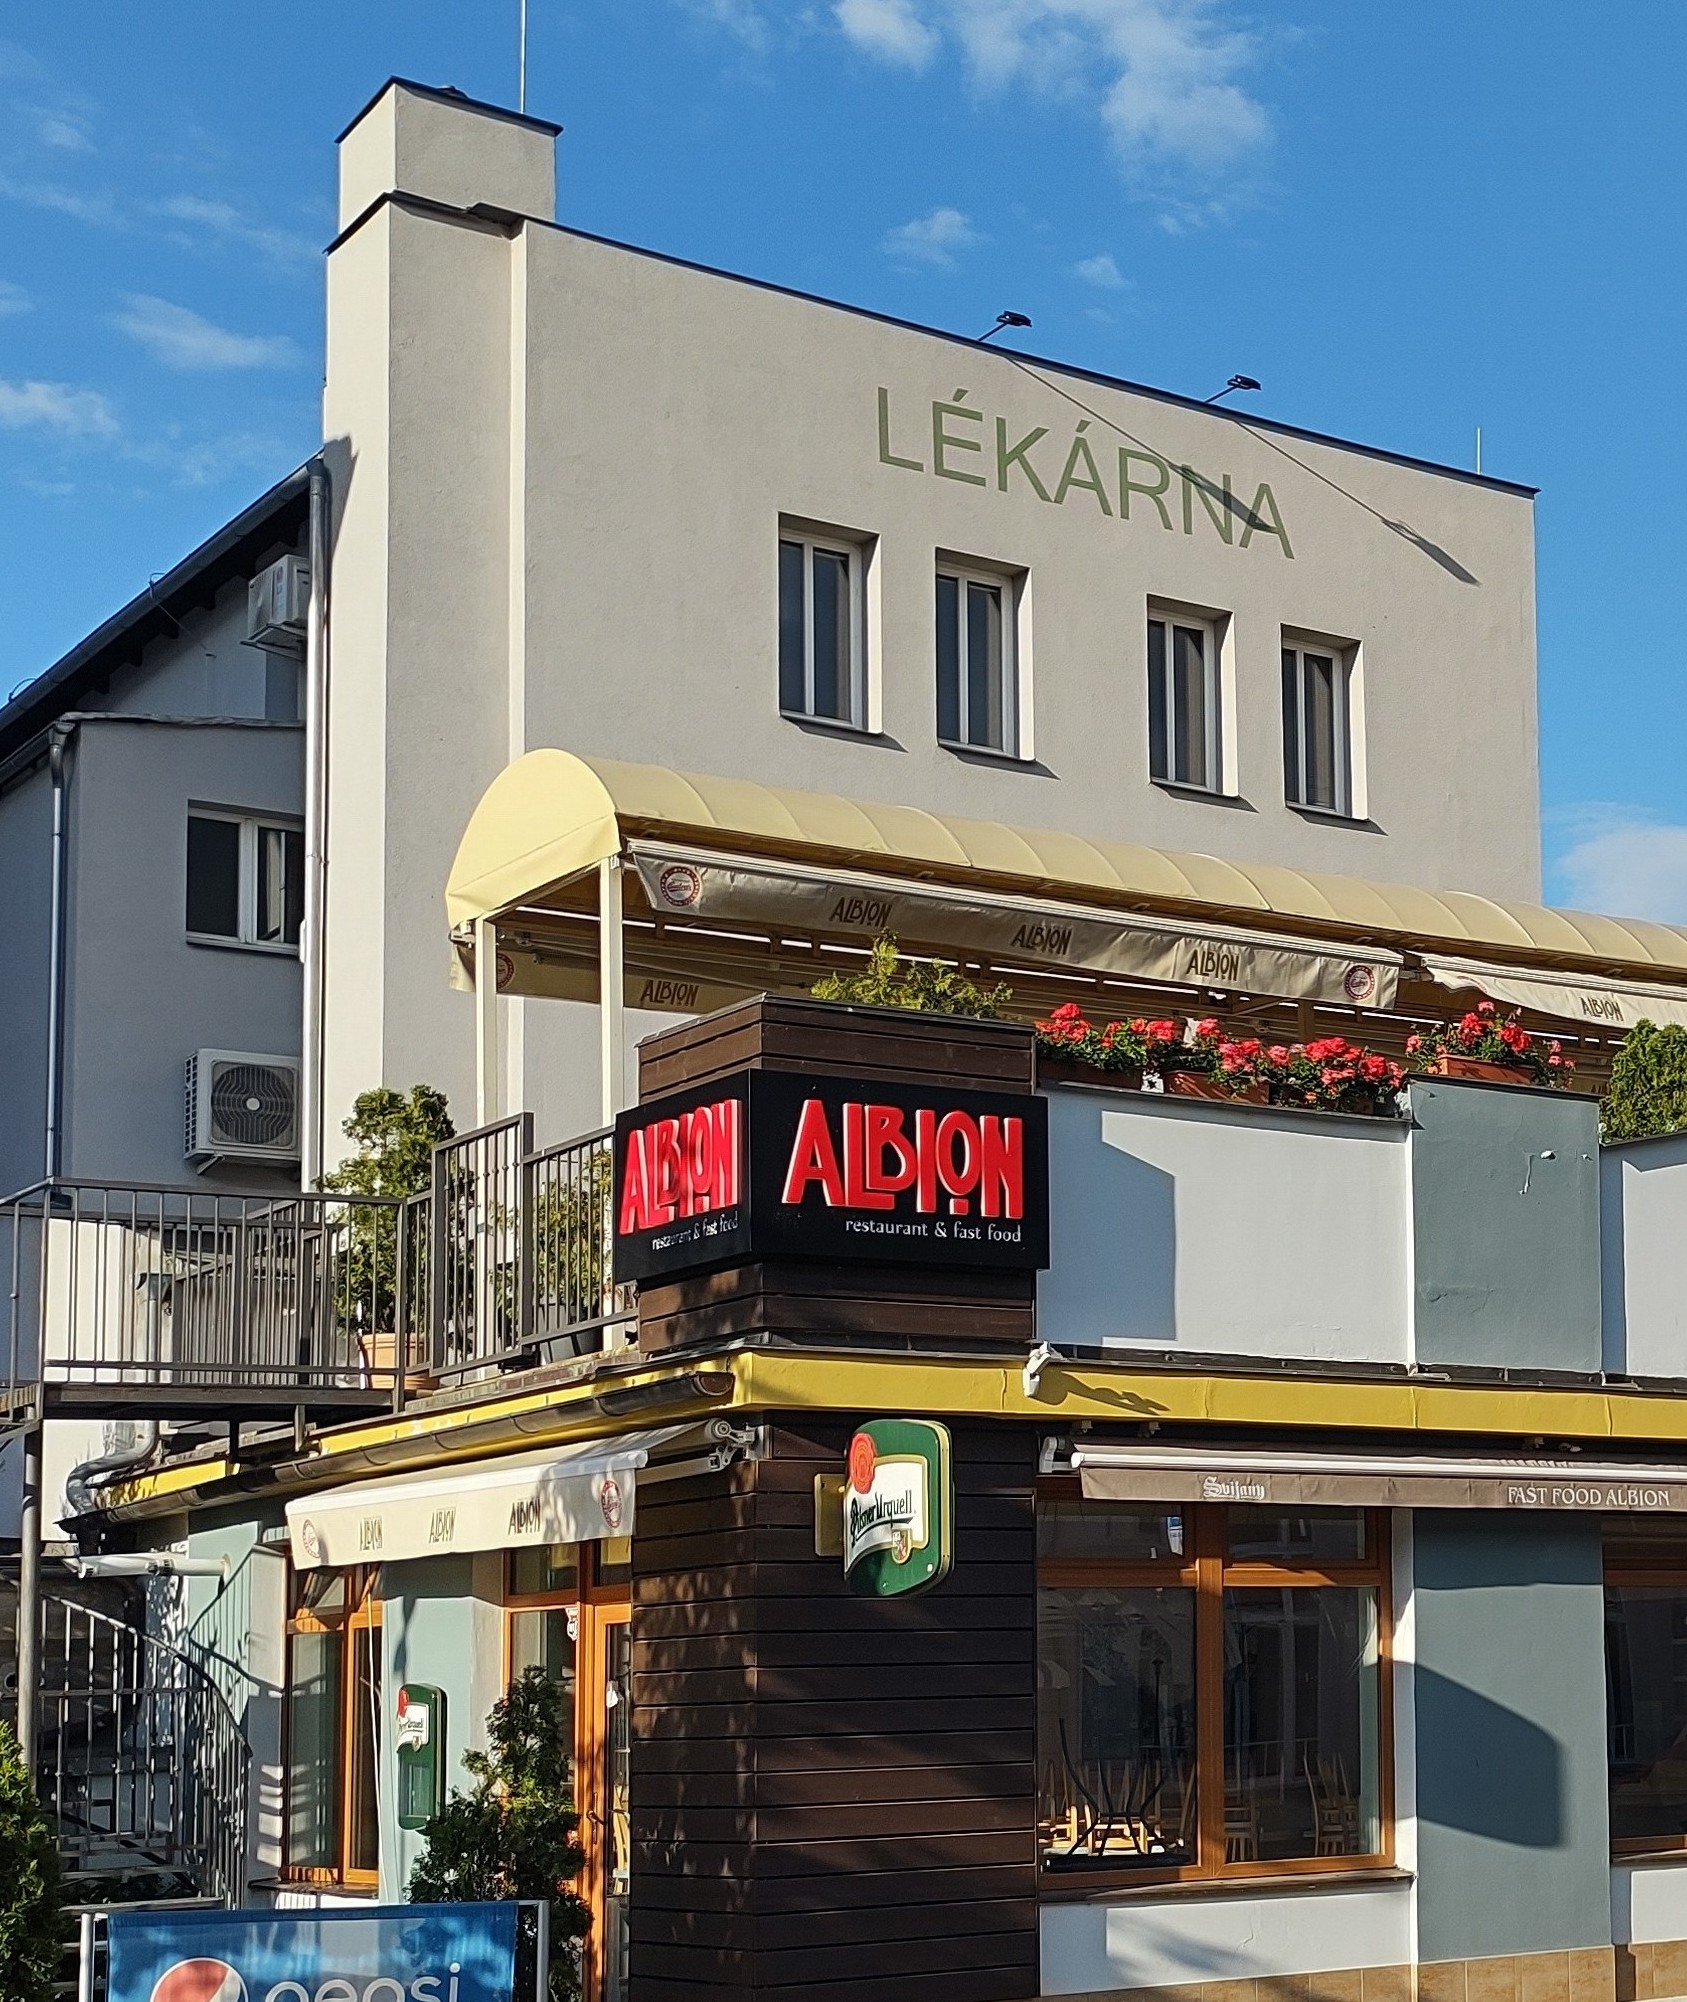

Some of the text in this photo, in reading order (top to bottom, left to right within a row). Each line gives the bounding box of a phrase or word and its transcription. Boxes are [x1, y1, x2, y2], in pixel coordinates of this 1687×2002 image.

[878, 386, 1295, 560] LÉKÁRNA
[828, 896, 893, 928] ALBION
[1010, 923, 1073, 955] ALBION
[1186, 948, 1240, 982] ALBION
[640, 979, 700, 1008] ALBION
[1580, 996, 1625, 1022] ALBION
[618, 1099, 740, 1234] ALBION
[780, 1097, 1024, 1220] ALBION
[845, 1218, 1022, 1243] restaurant & fast food
[875, 1489, 912, 1528] Urquell
[1507, 1486, 1670, 1506] FAST FOOD ALBION
[428, 1509, 457, 1545] ALBION
[507, 1496, 542, 1536] ALBION
